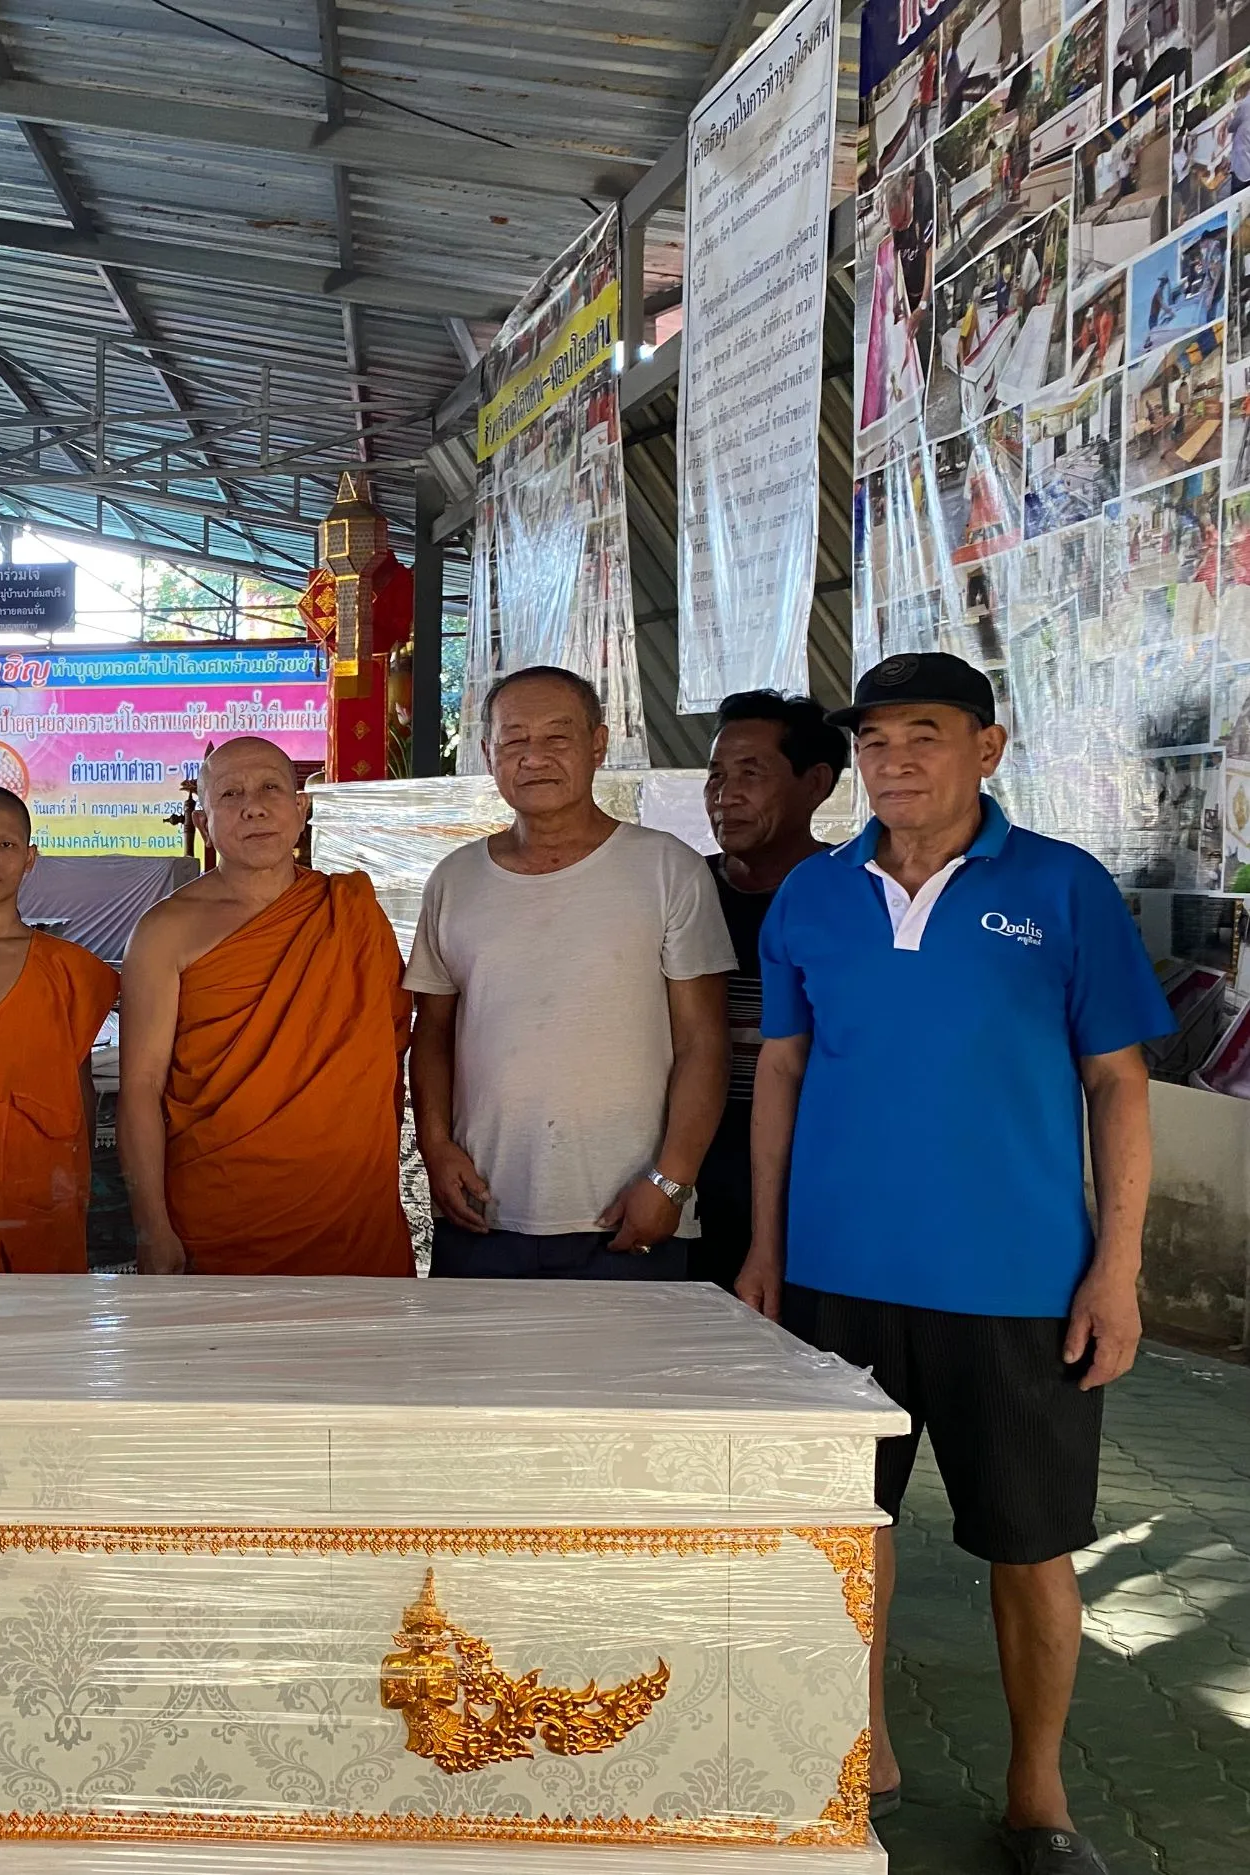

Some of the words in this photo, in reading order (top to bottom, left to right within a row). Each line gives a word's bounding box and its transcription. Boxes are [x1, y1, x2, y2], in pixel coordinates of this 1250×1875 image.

[70, 751, 162, 783] ตำบลท่าศาลา
[33, 798, 66, 815] วันเสาร์
[69, 793, 78, 815] ที่
[81, 802, 87, 815] 1
[91, 802, 138, 818] กรกฎาคม
[143, 801, 184, 816] พ.ศ.256
[980, 912, 1043, 938] Qoolis
